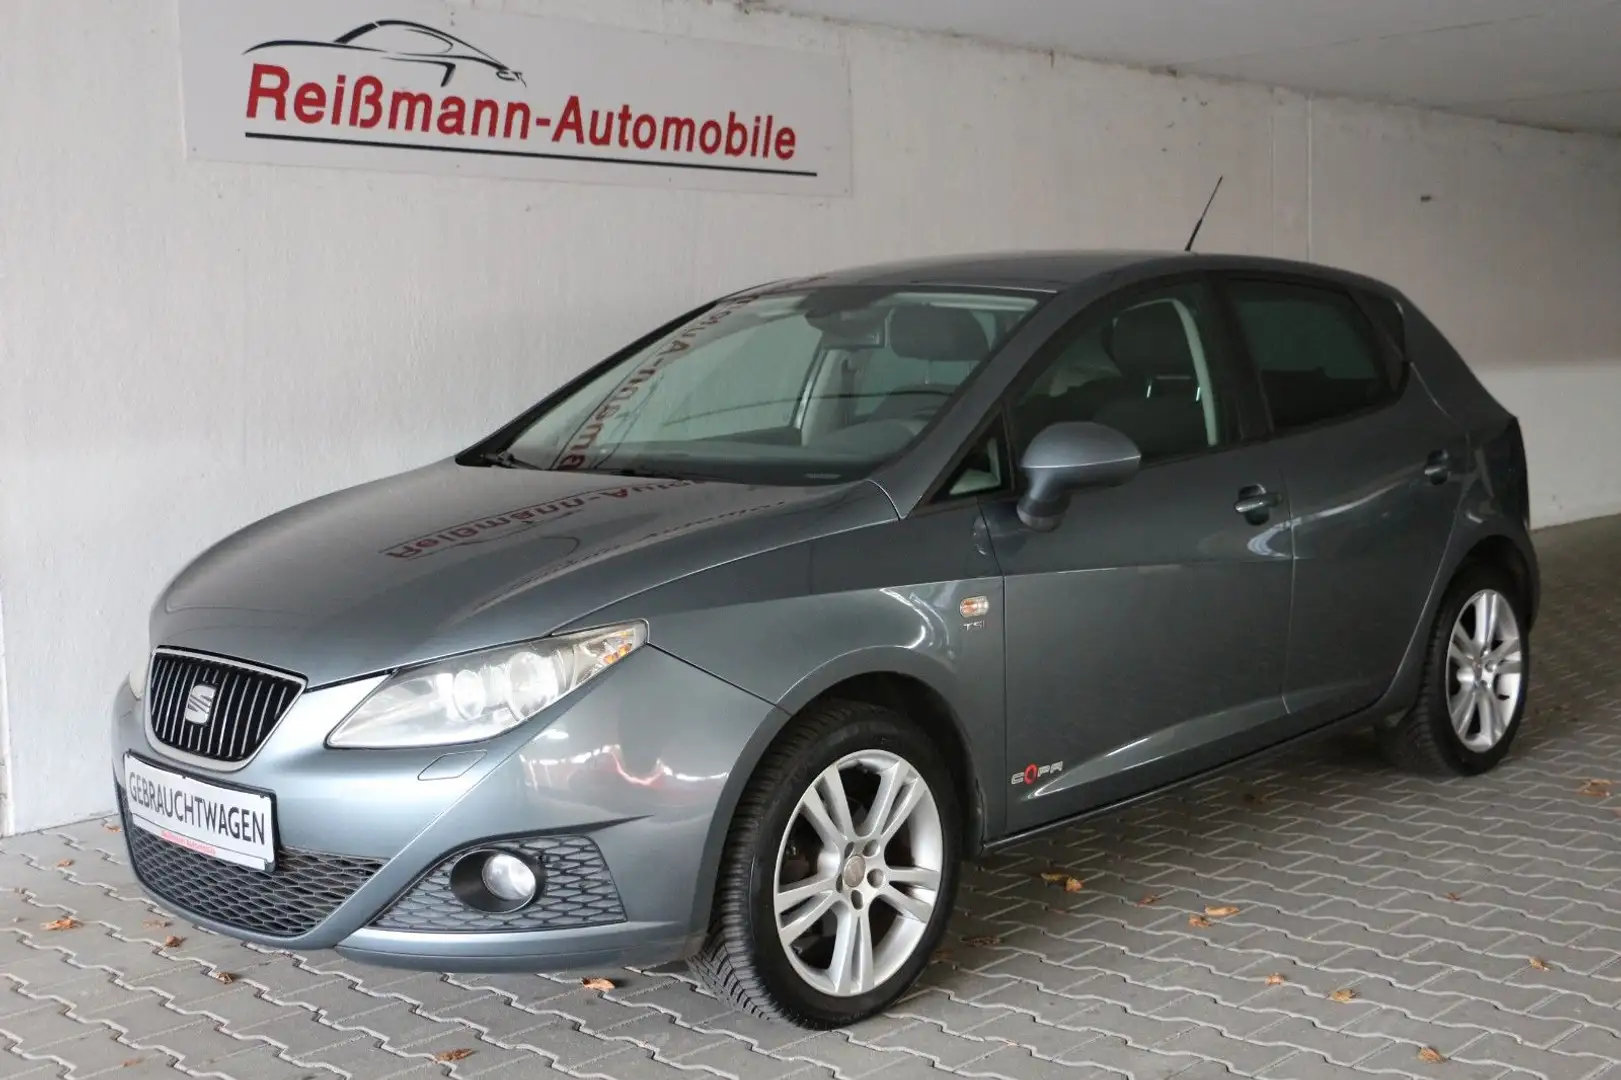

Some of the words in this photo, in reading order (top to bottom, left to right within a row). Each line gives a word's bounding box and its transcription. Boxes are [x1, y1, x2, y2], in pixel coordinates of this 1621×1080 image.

[245, 62, 797, 161] Reißmann-Automobile
[128, 771, 266, 846] GEBRAUCHTWAGEN
[1011, 761, 1063, 785] COPA
